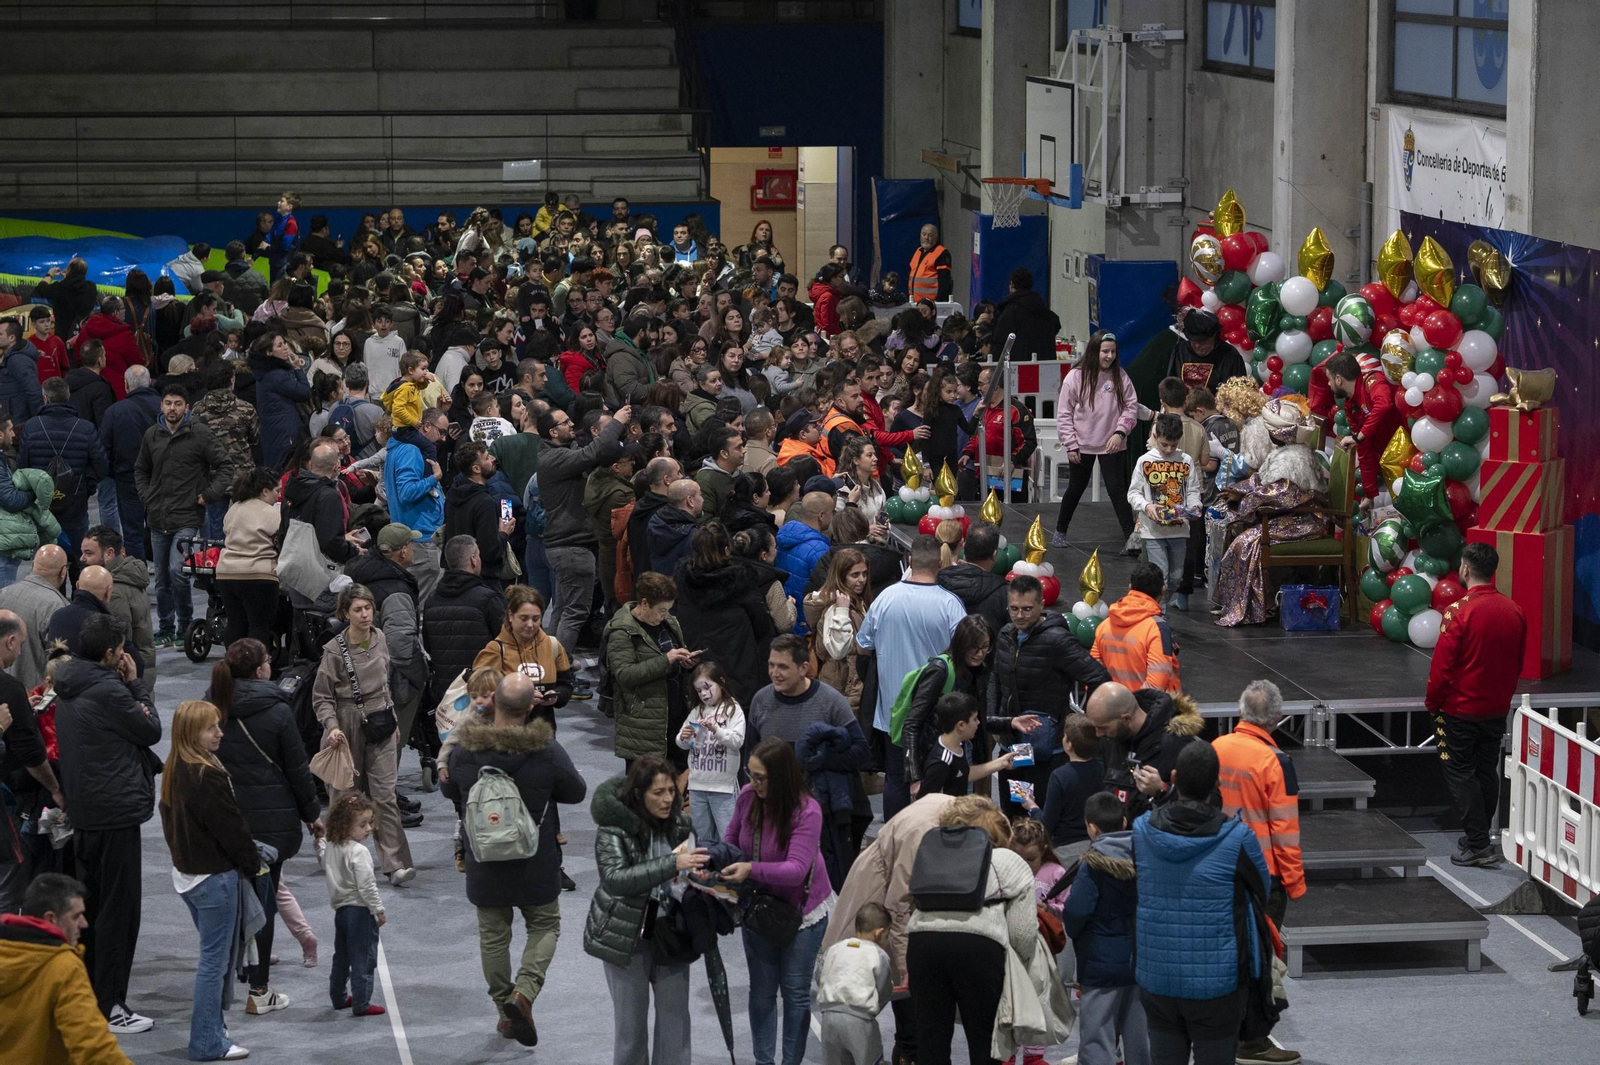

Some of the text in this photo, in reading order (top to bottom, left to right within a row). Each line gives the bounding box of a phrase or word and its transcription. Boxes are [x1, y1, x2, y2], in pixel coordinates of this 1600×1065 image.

[1453, 156, 1460, 172] de
[1462, 156, 1492, 179] Deportes
[1492, 164, 1500, 182] de
[1143, 461, 1190, 476] GARFIELD
